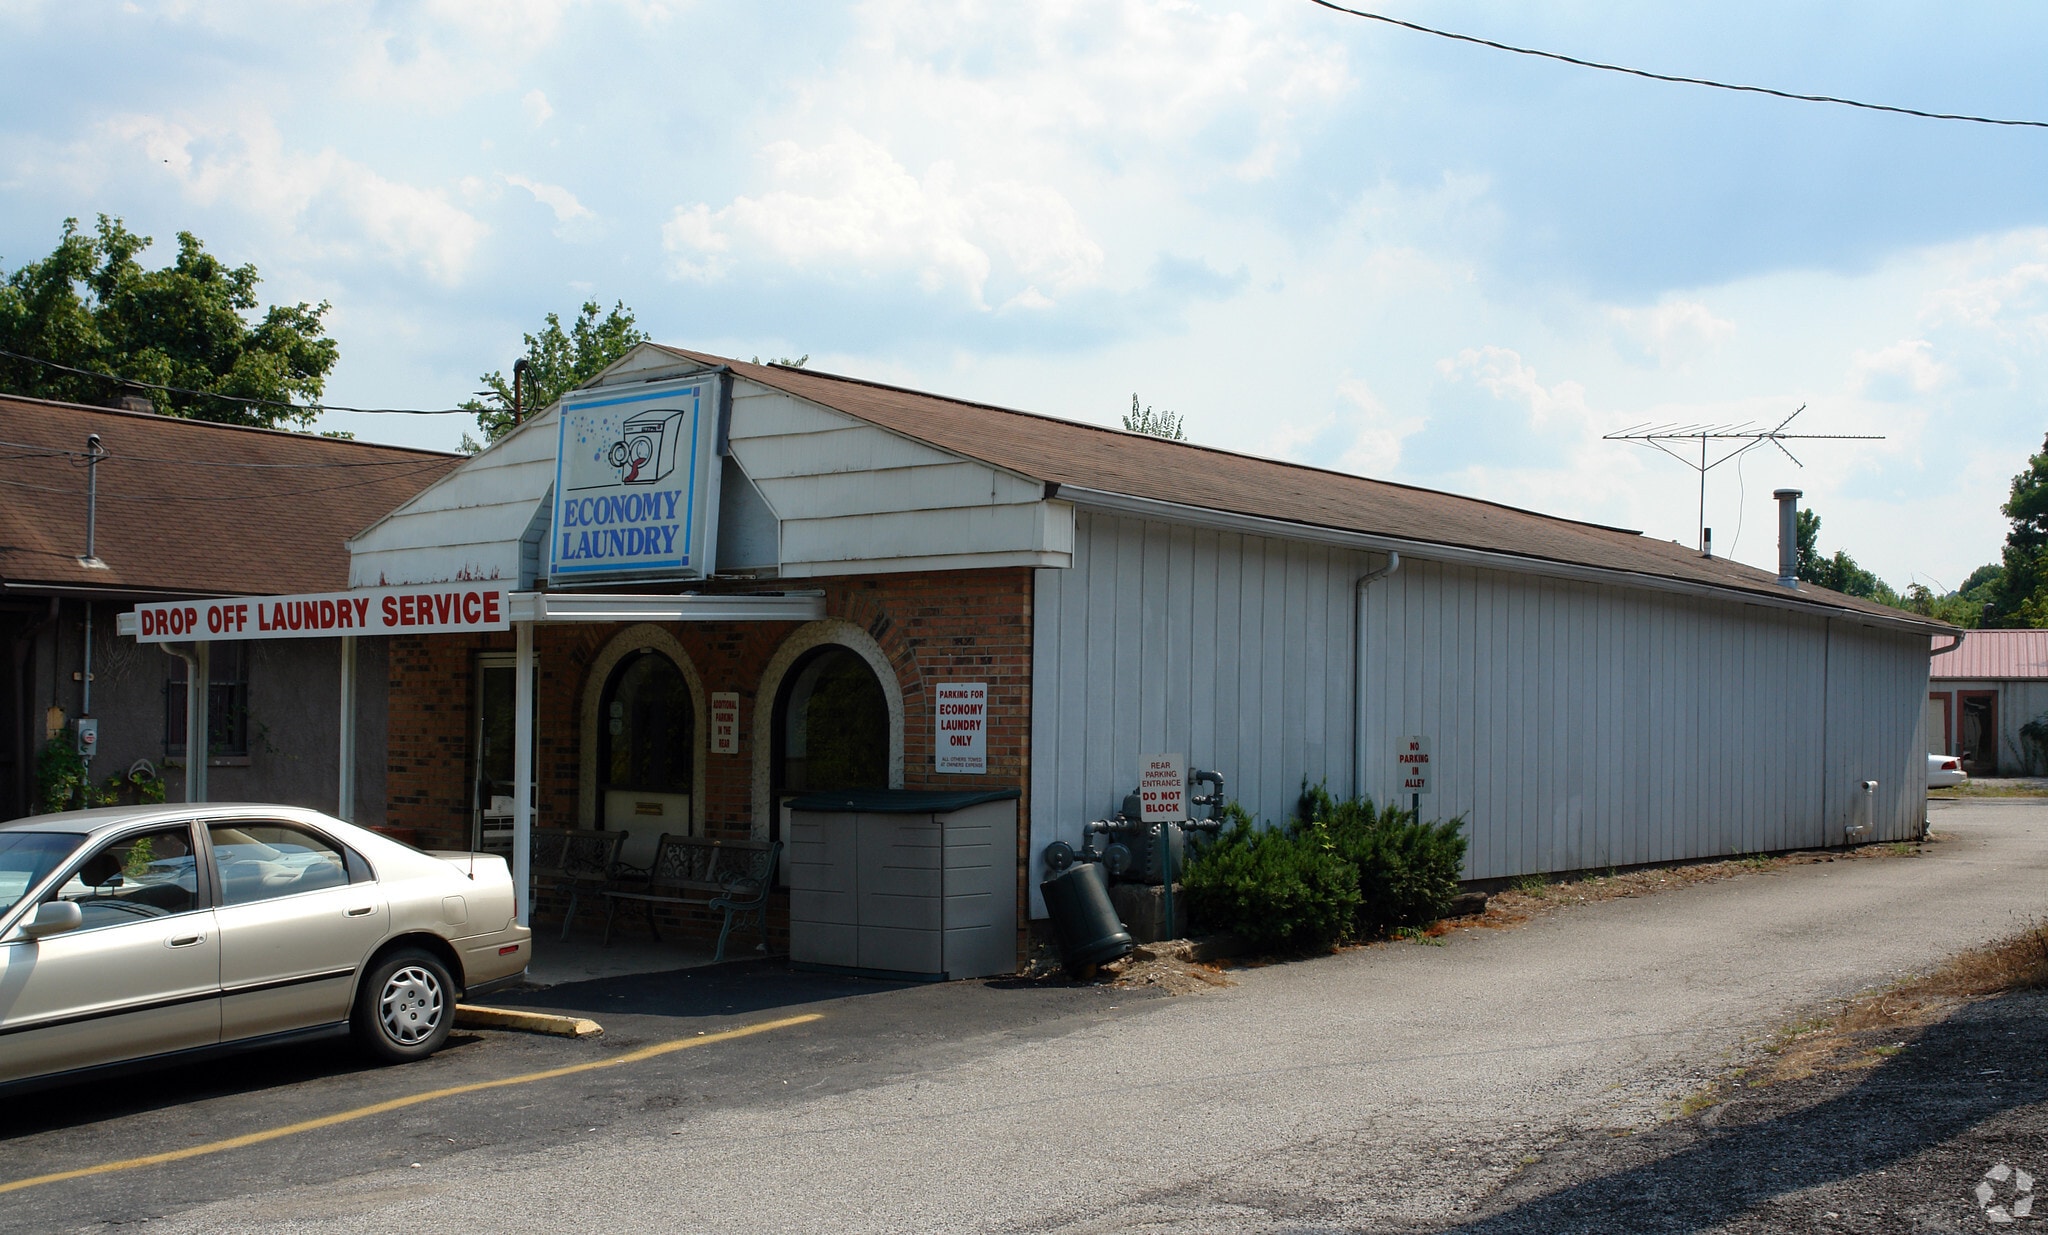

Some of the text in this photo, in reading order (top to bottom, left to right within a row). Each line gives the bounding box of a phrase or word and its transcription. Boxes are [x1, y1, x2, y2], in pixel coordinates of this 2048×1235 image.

[563, 490, 682, 527] ECONOMY
[561, 525, 679, 560] LAUNDRY
[141, 591, 500, 636] DROP OFF LAUNDRY SERVICE
[939, 690, 984, 699] PARKING FOR
[939, 704, 983, 715] ECONOMY
[941, 719, 981, 731] LAUNDRY
[950, 735, 972, 746] ONLY
[1409, 741, 1420, 751] NO
[1399, 754, 1429, 763] PARKING
[1150, 761, 1171, 770] REAR
[1145, 770, 1177, 779] PARKING
[1412, 766, 1419, 776] IN
[1142, 779, 1182, 788] ENTRANCE
[1404, 778, 1425, 788] ALLEY
[1142, 791, 1181, 801] DO NOT
[1145, 803, 1179, 813] BLOCK
